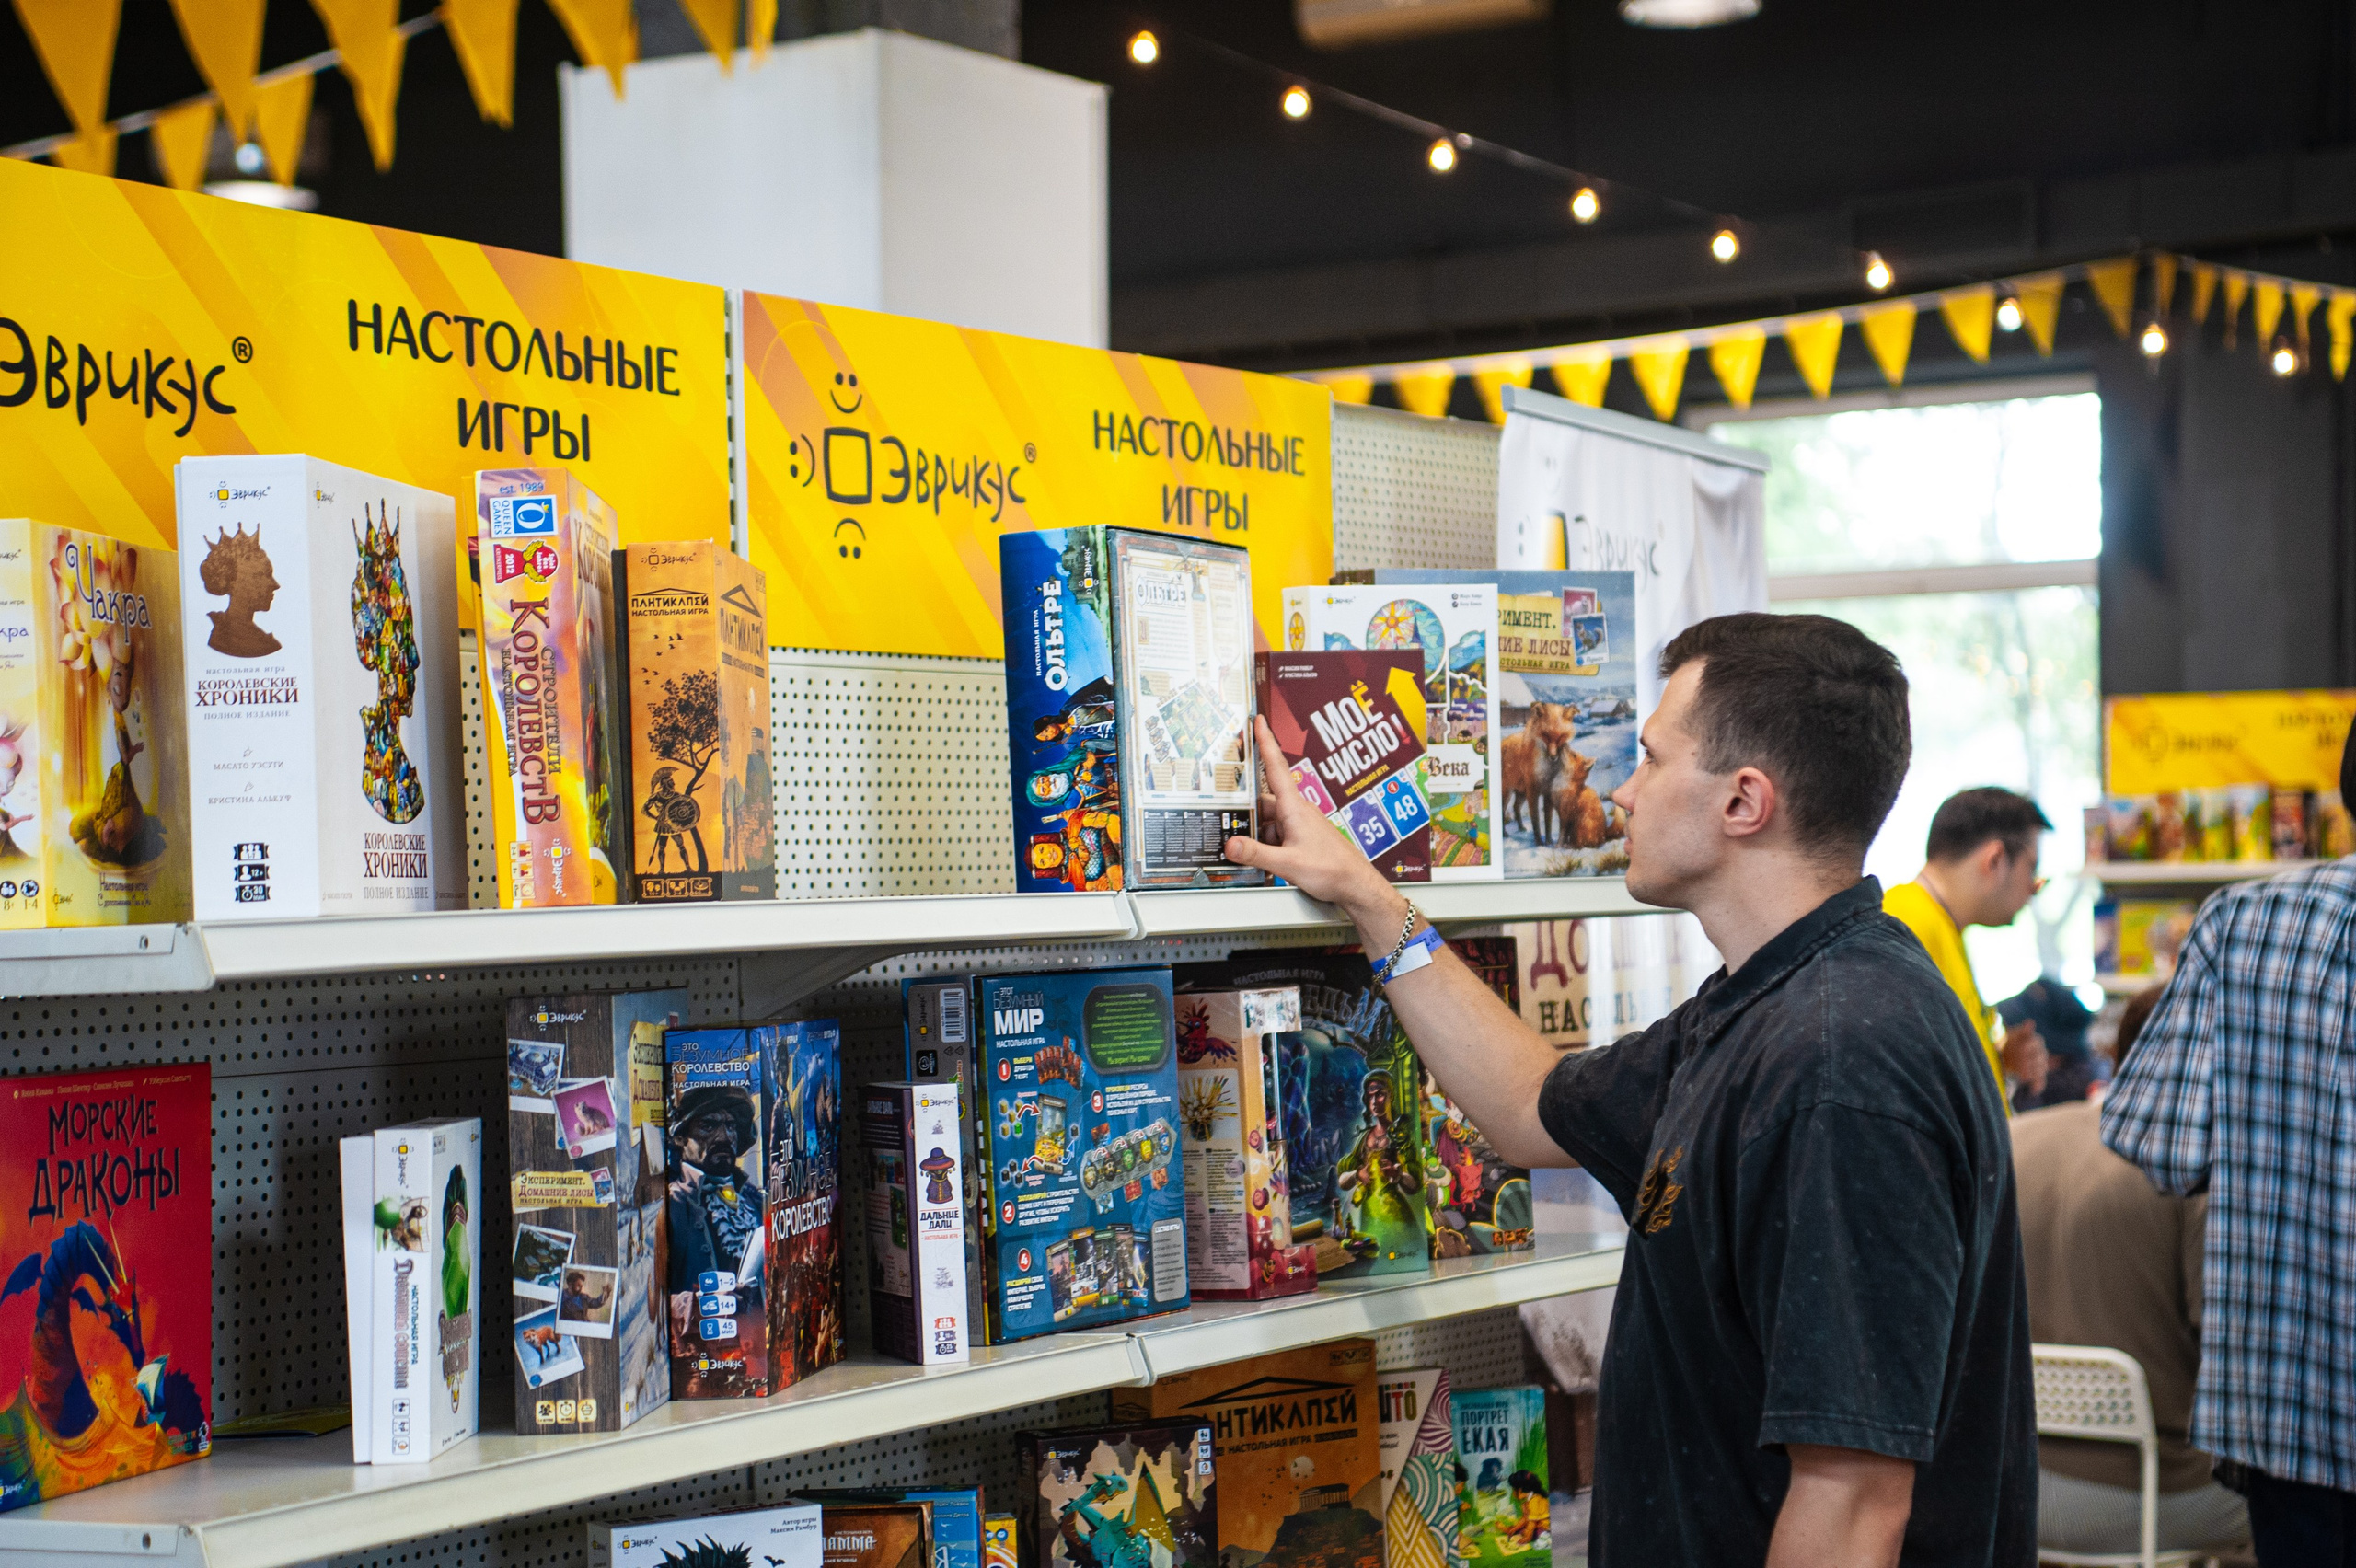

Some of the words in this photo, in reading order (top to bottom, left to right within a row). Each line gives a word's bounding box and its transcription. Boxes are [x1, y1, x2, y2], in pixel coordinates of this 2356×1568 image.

[347, 299, 680, 396] НАСТОЛЬНЫЕ
[457, 398, 592, 462] ИГРЫ
[1093, 409, 1306, 477] НАСТОЛЬНЫЕ
[520, 481, 544, 493] 1989
[492, 501, 503, 535] GAMES
[501, 500, 513, 535] QUEEN
[1161, 484, 1250, 533] ИГРЫ
[505, 553, 515, 574] 2012
[65, 543, 151, 643] Чакра
[631, 608, 686, 617] НАСТОЛЬНАЯ
[1034, 628, 1042, 677] НАСТОЛЬНАЯ
[1528, 639, 1572, 656] ЛИСЫ
[264, 665, 285, 674] игра
[1549, 661, 1570, 669] ИГРА
[198, 677, 298, 690] КОРОЛЕВСКИЕ
[195, 688, 299, 707] ХРОНИКИ
[501, 648, 517, 741] НАСТОЛЬНАЯ
[204, 711, 242, 720] ПОЛНОЕ
[246, 710, 291, 719] ИЗДАНИЕ
[541, 646, 561, 775] СТРОИТЕЛИ
[1318, 713, 1412, 785] ЧИСЛО!
[507, 744, 518, 778] ИГРА
[1427, 756, 1471, 778] Века
[1394, 794, 1418, 822] 48
[1359, 815, 1386, 845] 35
[364, 833, 426, 851] КОРОЛЕВСКИЕ
[363, 851, 428, 879] ХРОНИКИ
[364, 886, 394, 900] ПОЛНОЕ
[396, 886, 429, 899] ИЗДАНИЕ
[994, 1009, 1044, 1035] МИР
[682, 1043, 699, 1051] ЭТО
[996, 1040, 1032, 1048] НАСТОЛЬНАЯ
[671, 1061, 750, 1074] КОРОЛЕВСТВО
[673, 1079, 728, 1089] НАСТОЛЬНАЯ
[730, 1078, 751, 1087] ИГРА
[1093, 1095, 1101, 1107] 3
[49, 1094, 158, 1155] МОРСКИЕ
[780, 1138, 794, 1163] ЭТО
[29, 1147, 180, 1228] ДРАКОНЫ
[518, 1184, 568, 1198] ДОМАШНИЕ
[569, 1188, 594, 1198] ЛИСЫ
[771, 1195, 832, 1243] КОРОЛЕВСТВО
[920, 1210, 959, 1221] ДАЛЬНИЕ
[1004, 1205, 1012, 1217] 2
[929, 1220, 953, 1229] ДАЛИ
[1020, 1253, 1028, 1265] 4
[720, 1301, 734, 1309] 14+
[1216, 1389, 1357, 1439] НТИКАПЕЙ
[1461, 1410, 1509, 1425] ПОРТРЕТ
[1228, 1439, 1287, 1454] НАСТОЛЬНАЯ
[1289, 1435, 1312, 1445] ИГРА
[770, 1526, 794, 1534] Максим
[795, 1524, 817, 1532] Рамбур
[802, 1517, 817, 1526] игры
